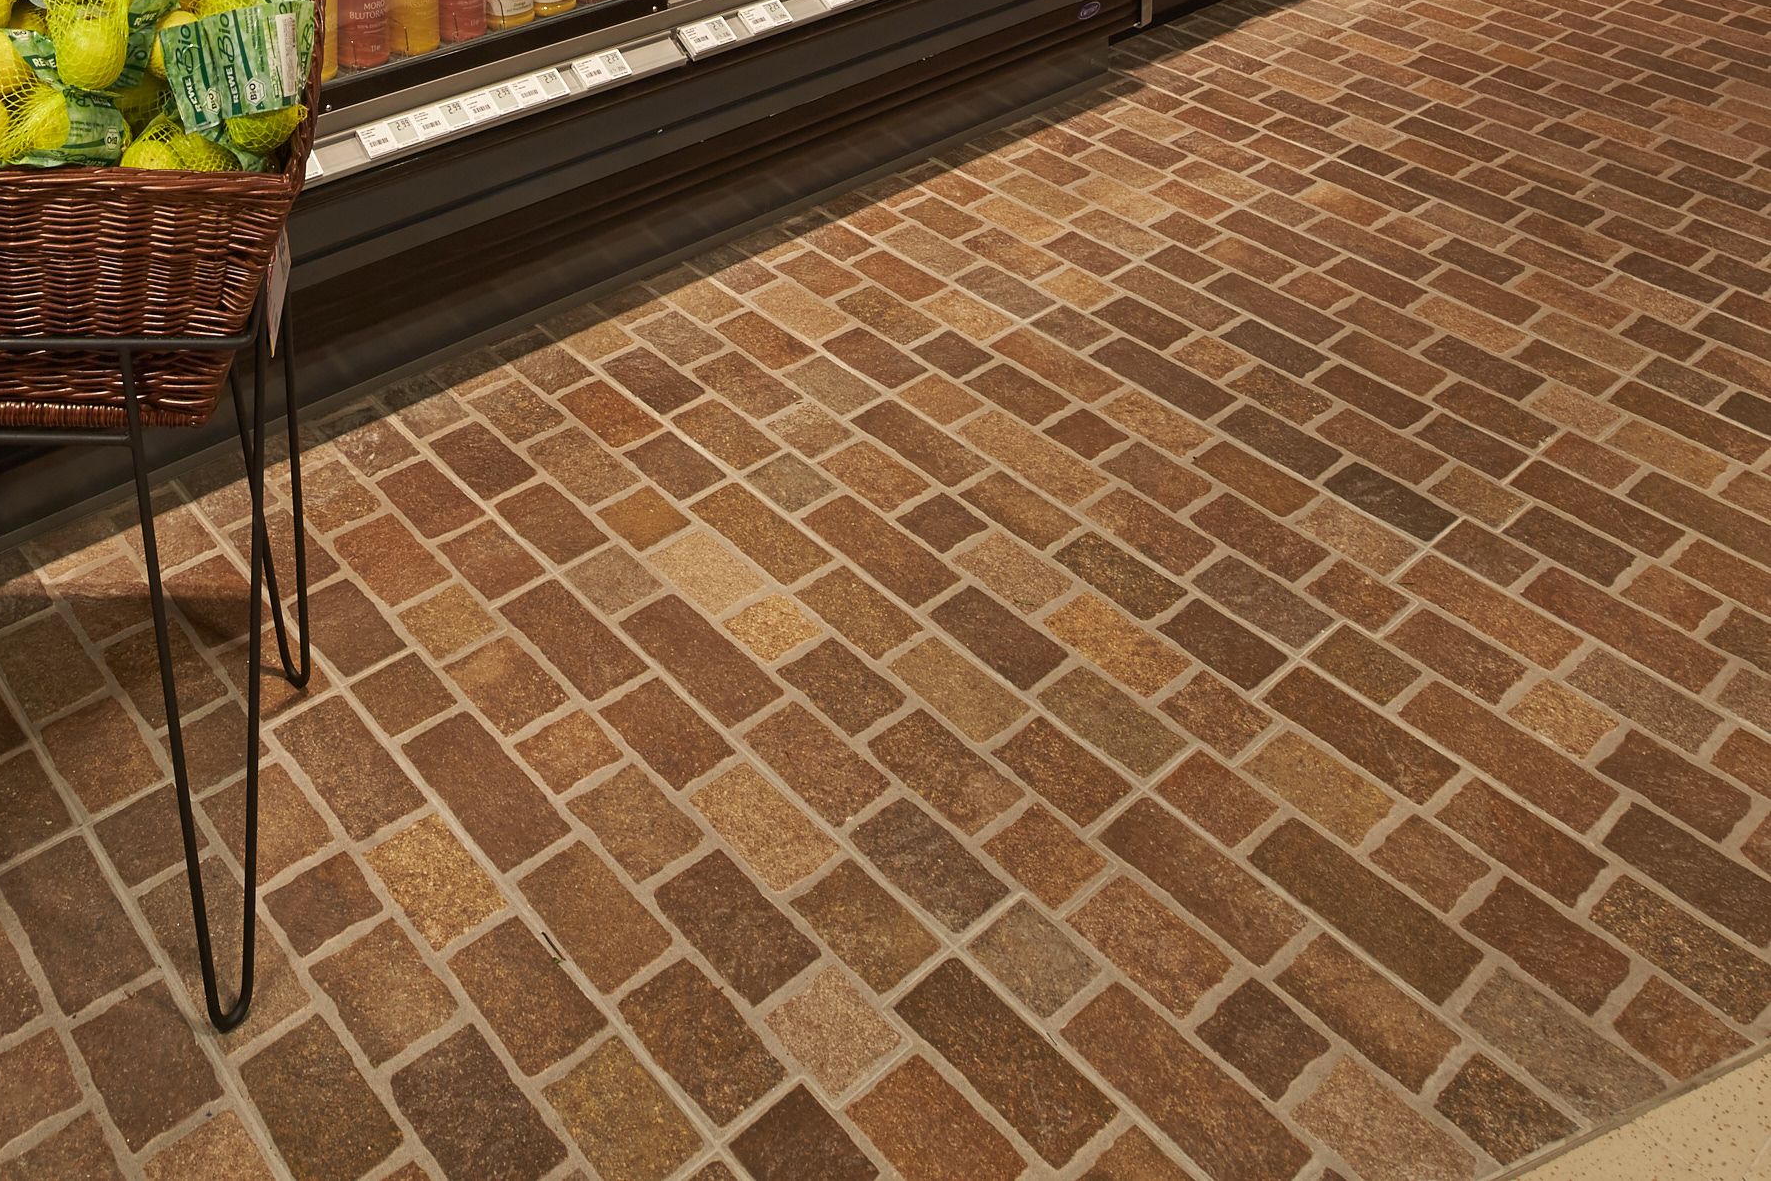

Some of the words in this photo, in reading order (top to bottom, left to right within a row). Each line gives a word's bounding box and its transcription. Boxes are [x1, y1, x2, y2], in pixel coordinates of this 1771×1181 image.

[176, 26, 194, 74] Bio
[217, 13, 235, 63] Bio
[185, 77, 203, 113] REWE
[226, 66, 240, 104] REWE
[497, 87, 510, 98] 2.99
[396, 120, 410, 131] 2.99
[448, 102, 461, 114] 2.99
